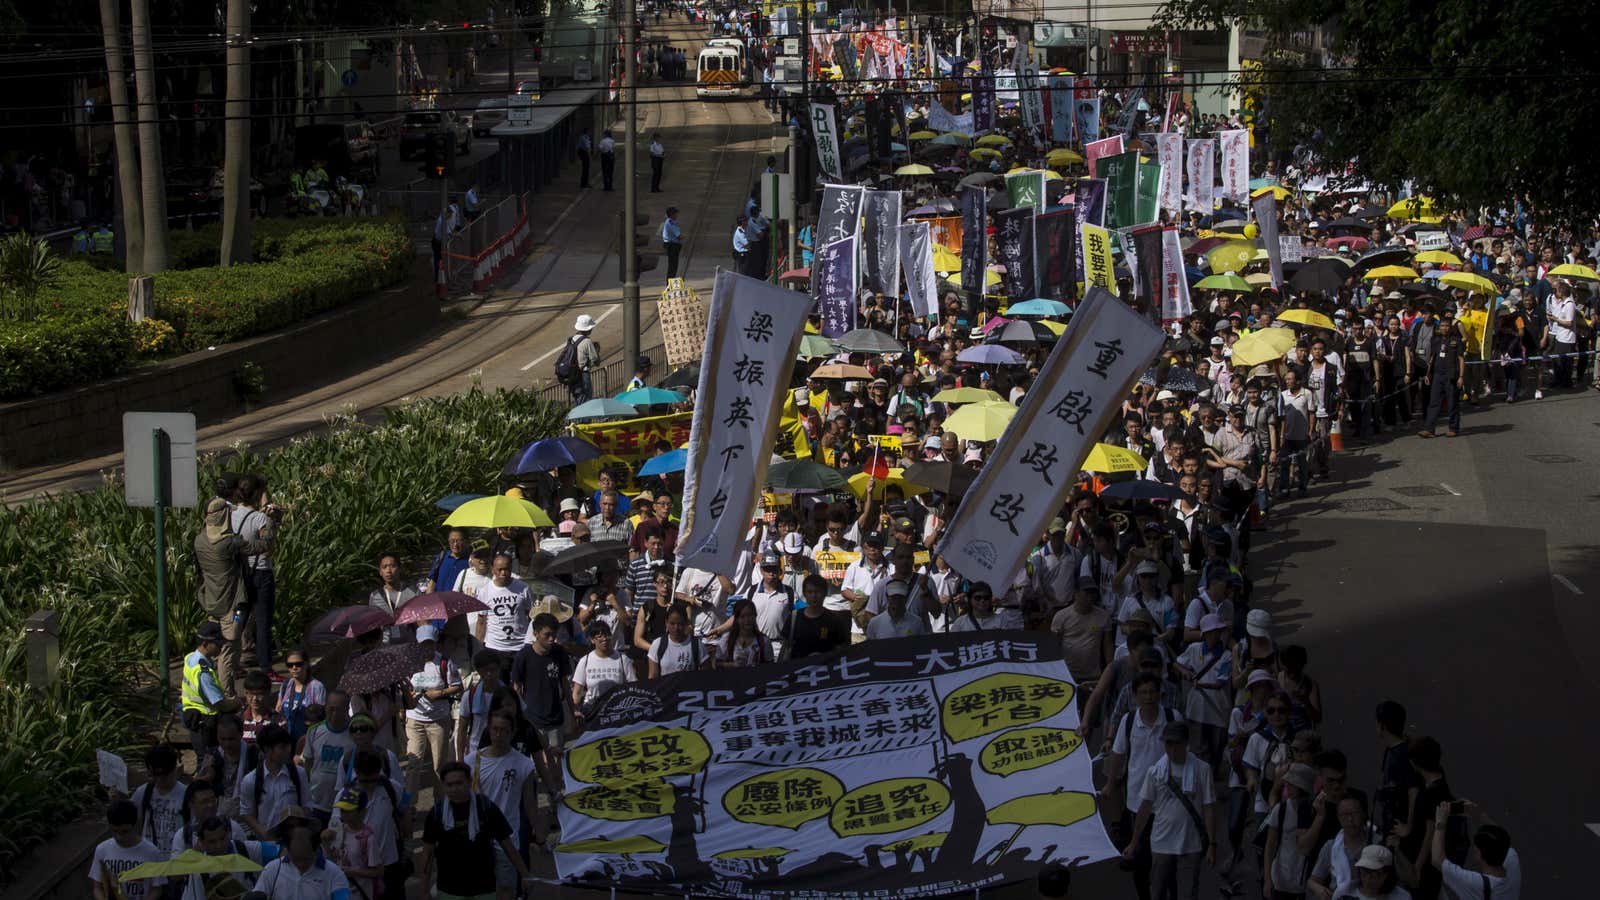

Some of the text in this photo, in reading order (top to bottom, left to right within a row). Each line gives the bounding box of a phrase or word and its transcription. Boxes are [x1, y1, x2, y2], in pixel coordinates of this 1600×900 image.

[709, 309, 774, 520] 梁振英下台
[493, 595, 518, 604] WHY
[493, 603, 518, 616] CY
[677, 640, 1039, 712] 20年七一大遊行
[950, 682, 1066, 716] 梁振英
[720, 695, 930, 733] 建設民主香港
[971, 703, 1041, 728] 下台
[723, 713, 934, 751] 重奪我城未來
[993, 731, 1064, 756] 取消
[596, 734, 683, 762] 修改
[991, 739, 1077, 769] 功能組別
[592, 755, 693, 779] 基本法
[742, 777, 823, 803] 廢除
[846, 782, 929, 817] 追究
[735, 795, 833, 817] 公安條例
[843, 800, 944, 830] 黑警責任
